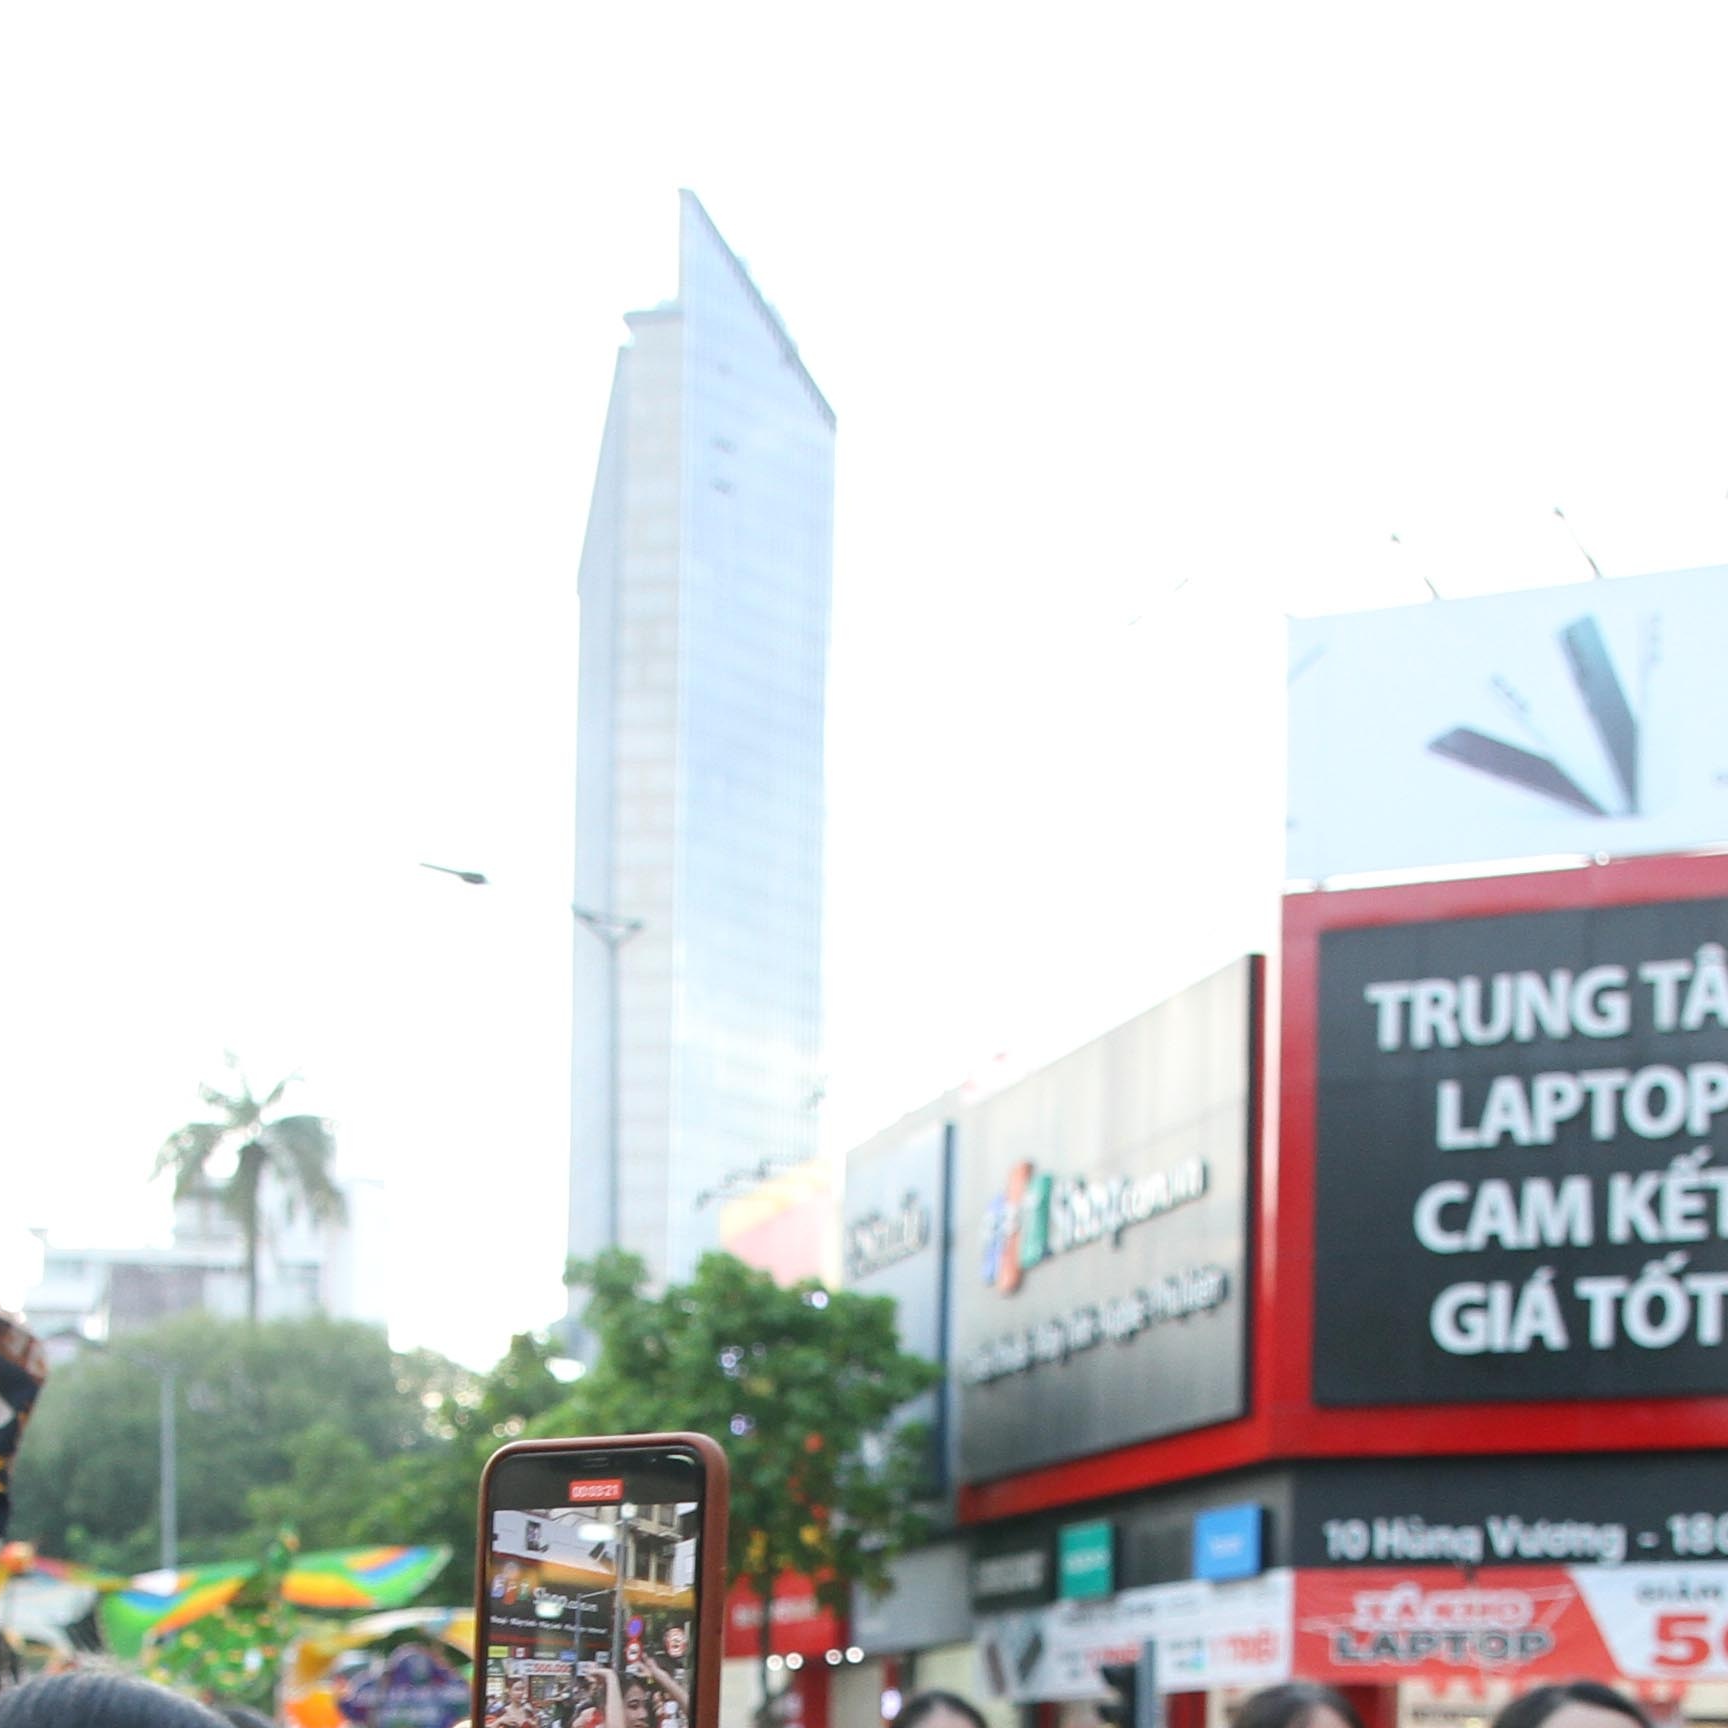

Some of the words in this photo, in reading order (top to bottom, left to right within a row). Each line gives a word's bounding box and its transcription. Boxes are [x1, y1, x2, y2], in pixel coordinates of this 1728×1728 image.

[1365, 966, 1630, 1051] TRUNG
[1413, 1175, 1593, 1254] CAM
[1430, 1266, 1568, 1355] GIÁ
[1323, 1519, 1370, 1560] 10
[1373, 1513, 1484, 1562] Hùng
[1486, 1515, 1627, 1564] Vương
[1334, 1629, 1553, 1664] LAPTOP
